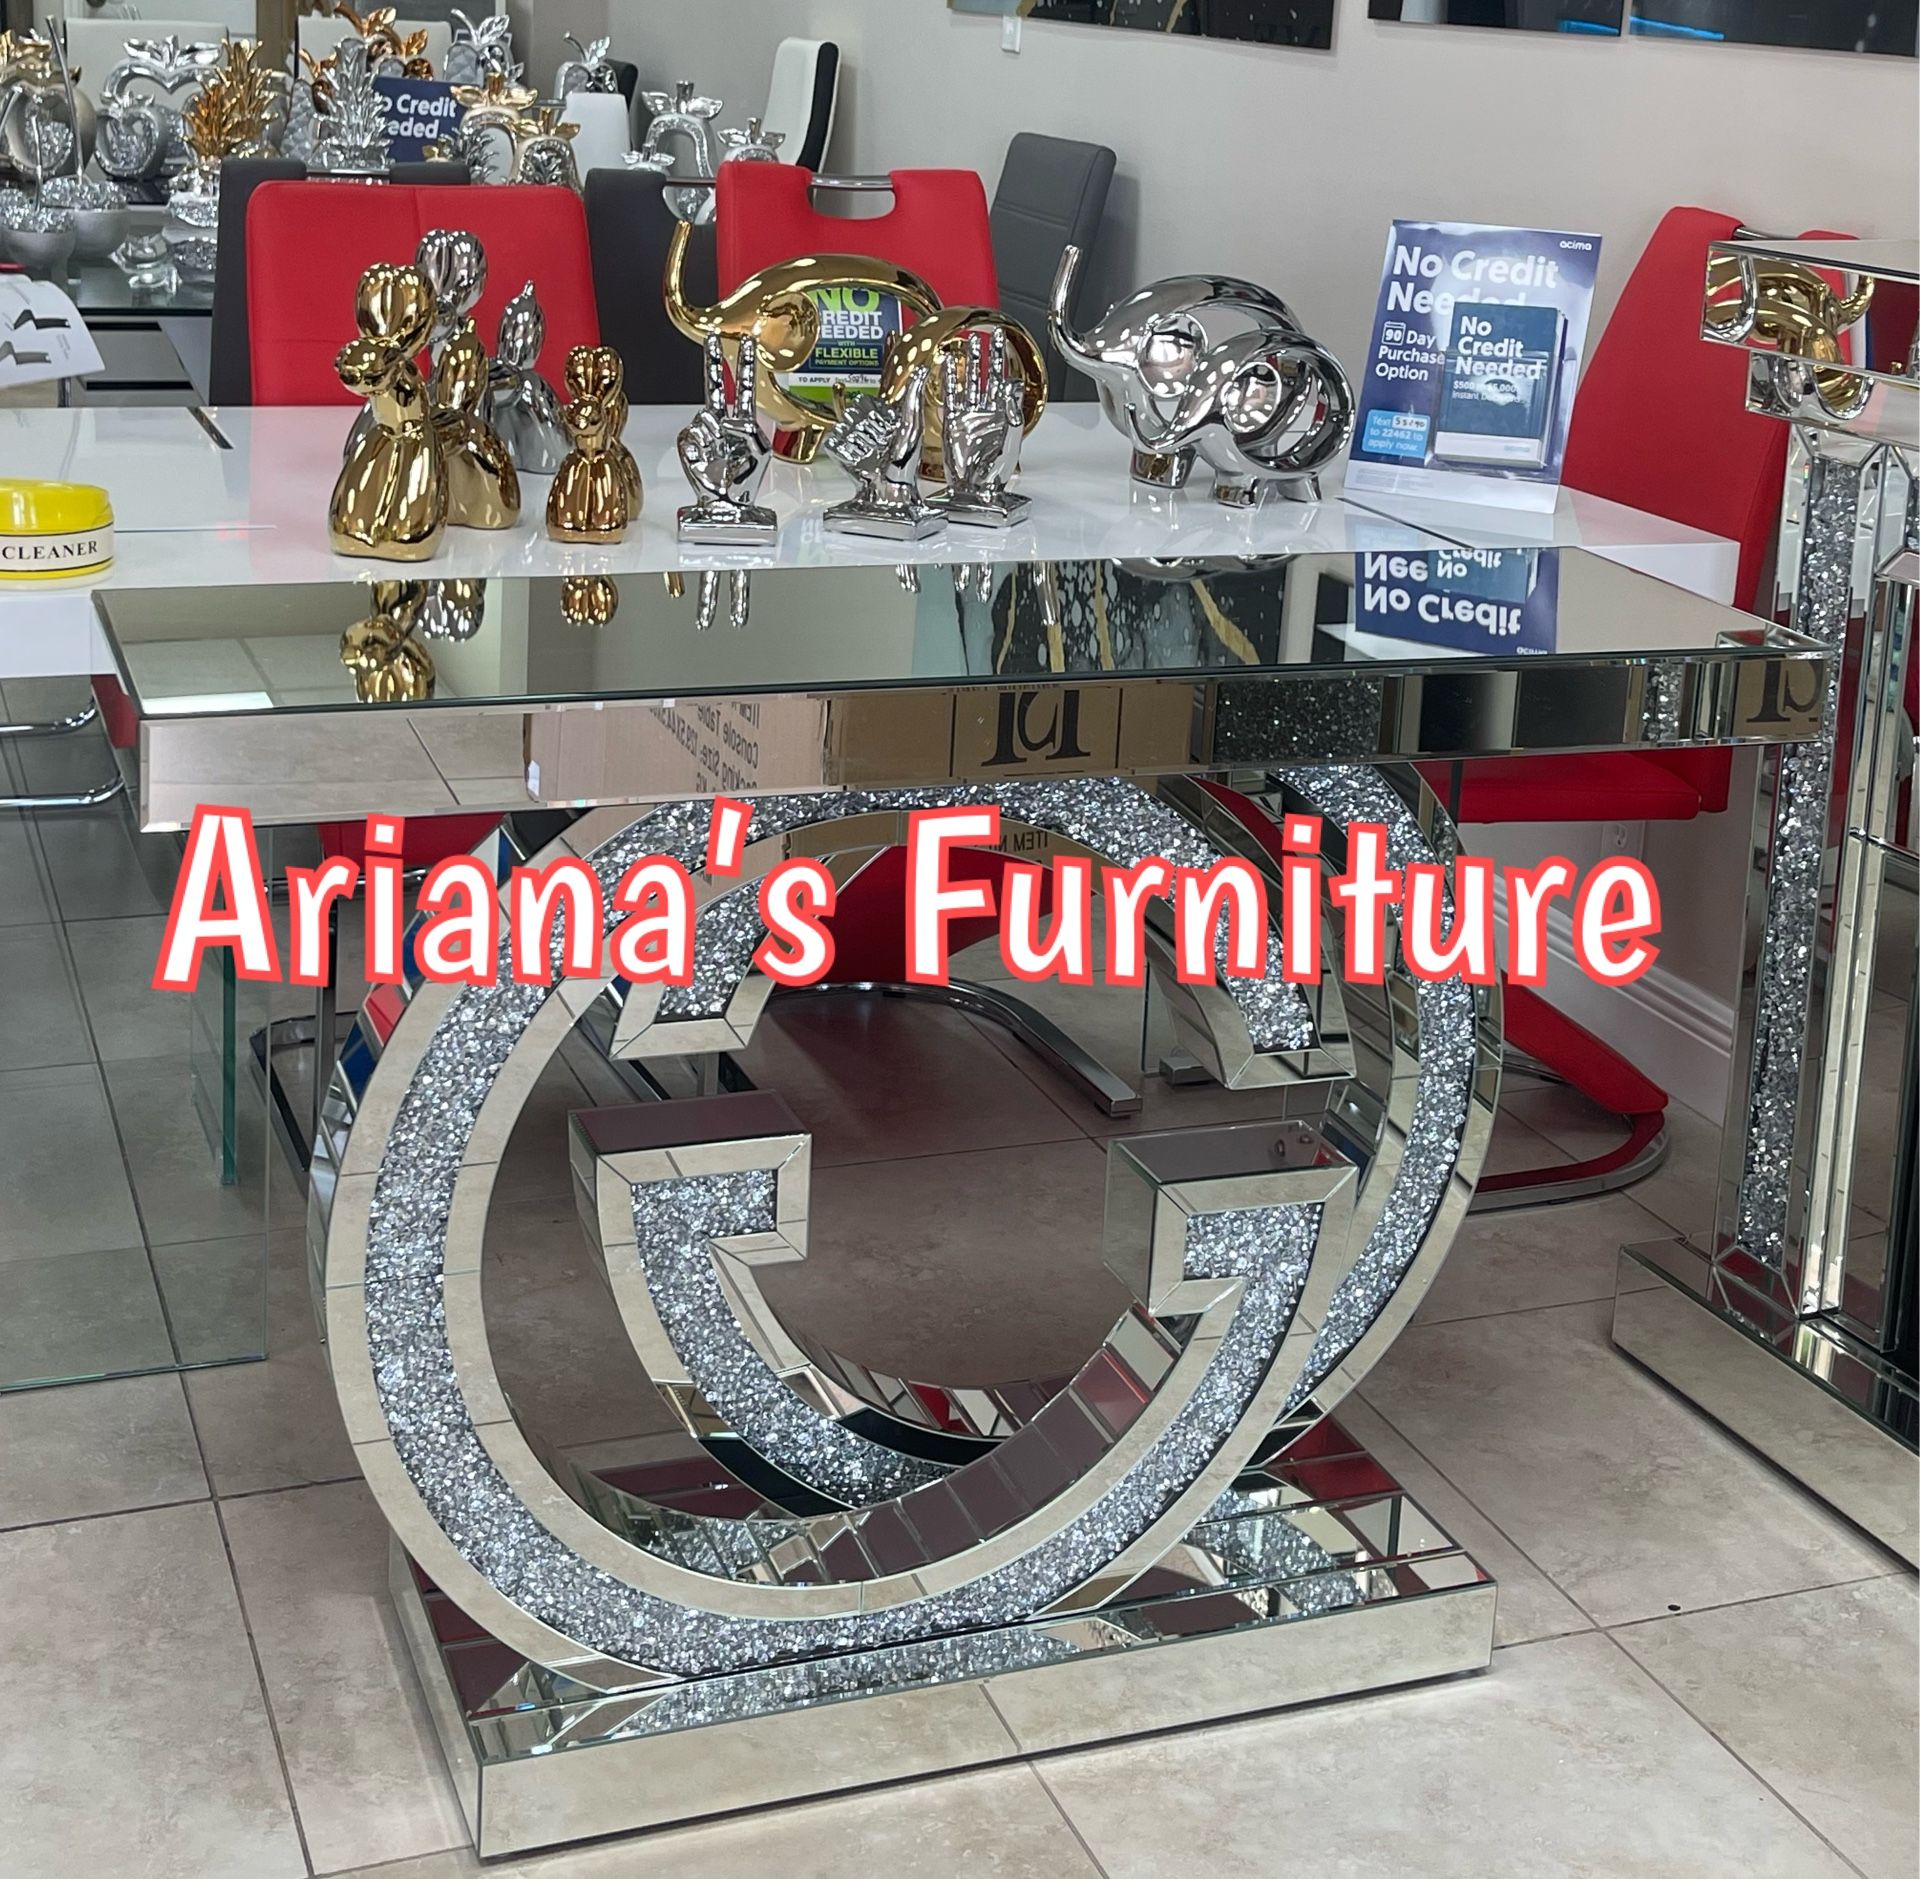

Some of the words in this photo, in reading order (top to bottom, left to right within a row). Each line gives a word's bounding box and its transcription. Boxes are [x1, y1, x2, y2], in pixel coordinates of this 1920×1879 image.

[396, 94, 457, 118] Credit
[1559, 240, 1592, 251] acima
[1393, 245, 1443, 278] No
[1451, 250, 1559, 289] Credit
[808, 287, 879, 314] NO
[820, 311, 882, 326] REDIT
[1460, 316, 1492, 336] No
[820, 325, 884, 340] EEDED
[1385, 330, 1402, 342] 90
[1406, 330, 1436, 349] Day
[815, 347, 878, 359] FLEXIBLE
[1378, 346, 1445, 365] Purchase
[1458, 336, 1524, 358] Credit
[1375, 363, 1428, 381] Option
[1455, 356, 1541, 380] Needed
[2, 540, 98, 560] CLEANER
